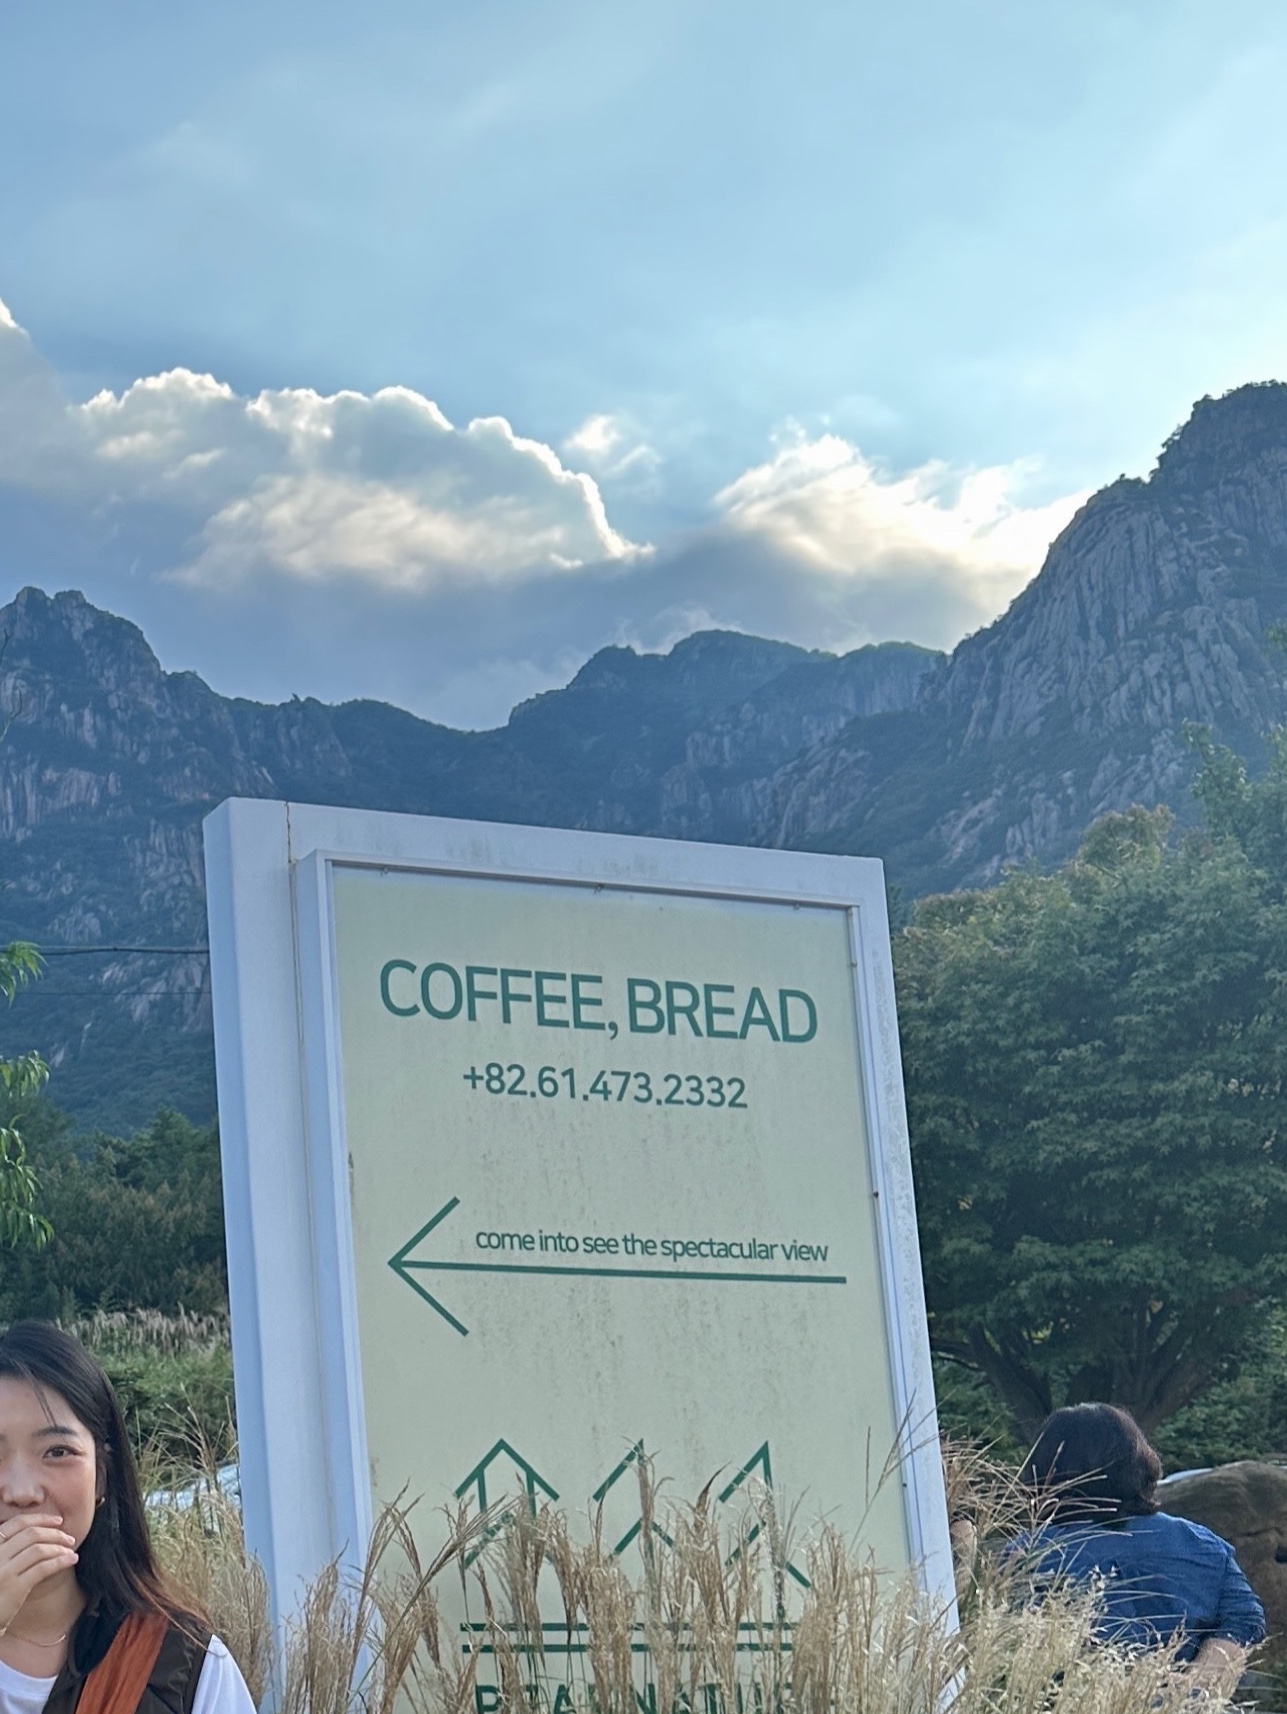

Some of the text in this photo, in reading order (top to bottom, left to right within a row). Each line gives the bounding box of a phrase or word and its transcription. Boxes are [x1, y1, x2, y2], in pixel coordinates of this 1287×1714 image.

[379, 958, 819, 1044] COFFEE, BREAD
[462, 1062, 749, 1109] +82.61.473.2332
[475, 1230, 829, 1263] come into see the spectacular view
